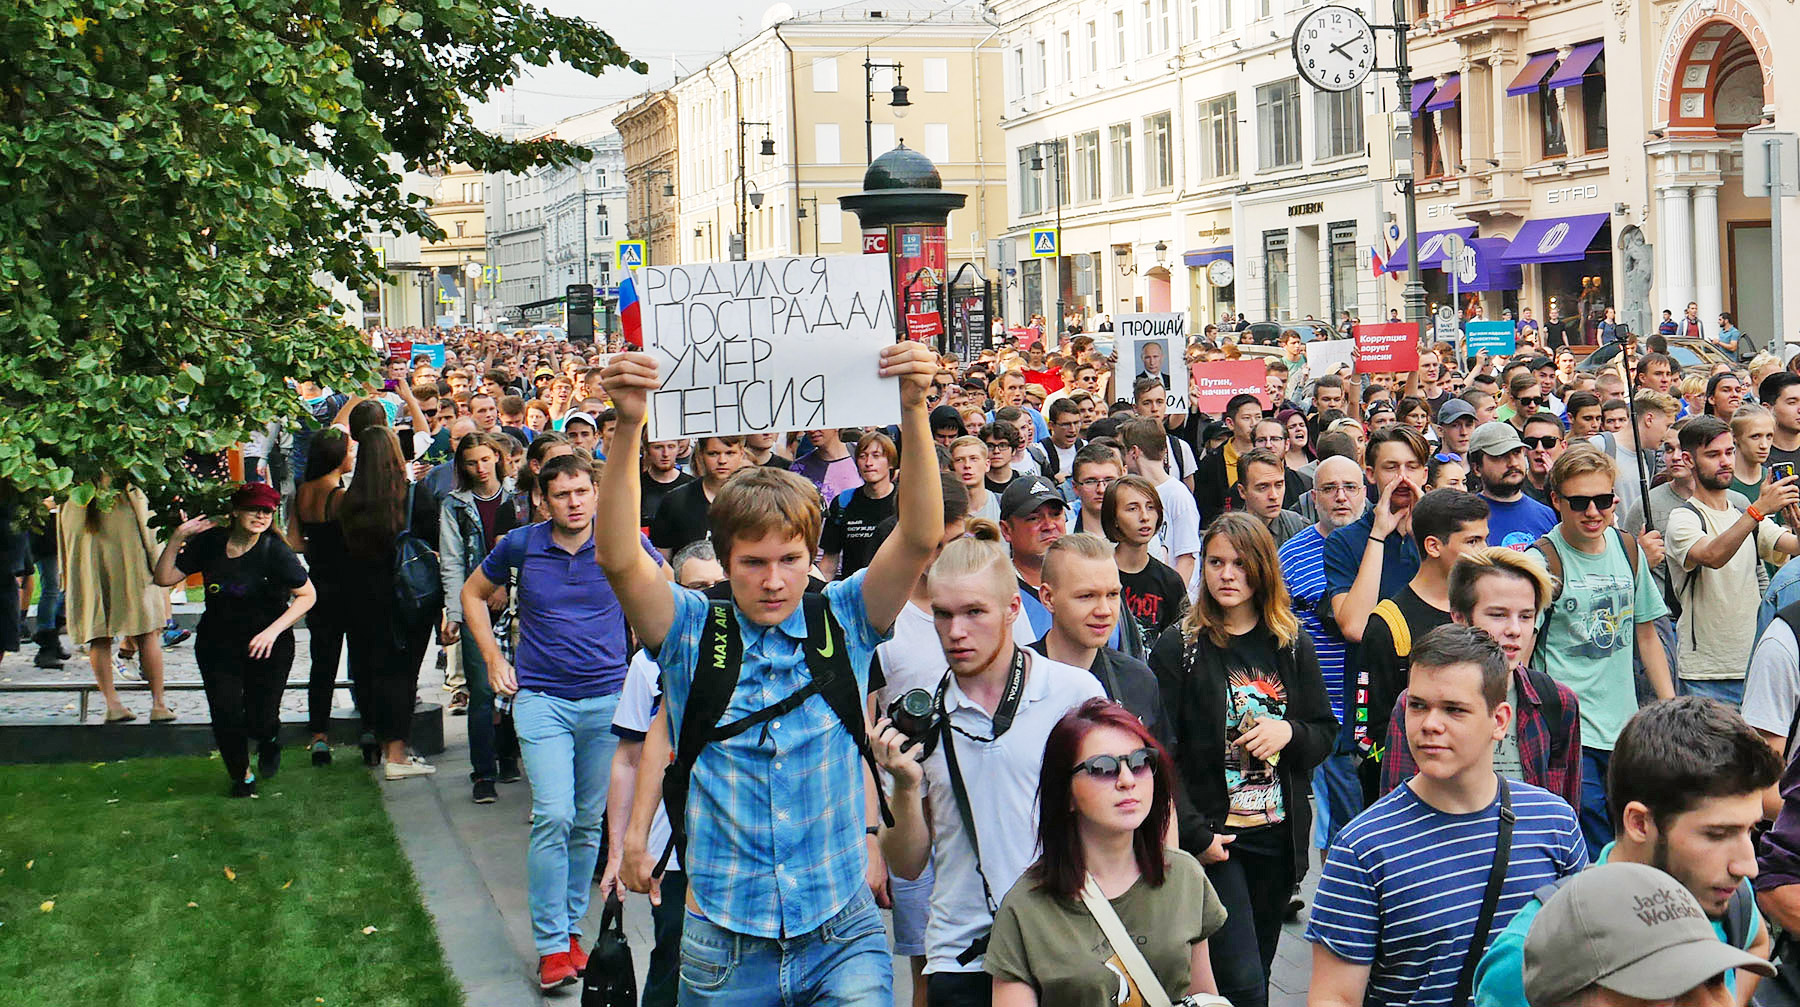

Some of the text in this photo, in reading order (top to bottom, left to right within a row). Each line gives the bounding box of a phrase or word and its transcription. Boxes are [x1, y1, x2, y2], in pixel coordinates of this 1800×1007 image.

[1318, 19, 1325, 28] 11
[1331, 14, 1341, 24] 12
[1348, 19, 1352, 28] 1
[1308, 29, 1318, 39] 10
[1358, 30, 1364, 39] 2
[1718, 0, 1774, 86] ПАССАЖ
[1304, 44, 1310, 54] 9
[1362, 45, 1368, 54] 3
[1308, 59, 1315, 68] 8
[1358, 60, 1364, 68] 4
[1320, 70, 1326, 79] 7
[1334, 74, 1340, 83] 6
[1348, 70, 1355, 79] 5
[1547, 184, 1598, 204] ETRO
[646, 257, 829, 305] РОДИЛСЯ
[653, 289, 896, 348] ПОСТРАДАЛ
[1121, 313, 1184, 337] ПРОЩАЙ
[1360, 335, 1407, 343] Коррупция
[660, 337, 773, 390] УМЕР
[1201, 378, 1232, 387] Путин,
[1239, 386, 1261, 394] себя
[653, 374, 827, 439] ПЕНСИЯ
[1566, 600, 1574, 610] 8
[713, 606, 728, 669] MAX AIR
[1007, 668, 1022, 702] DIGITAL
[1632, 888, 1674, 911] Jack
